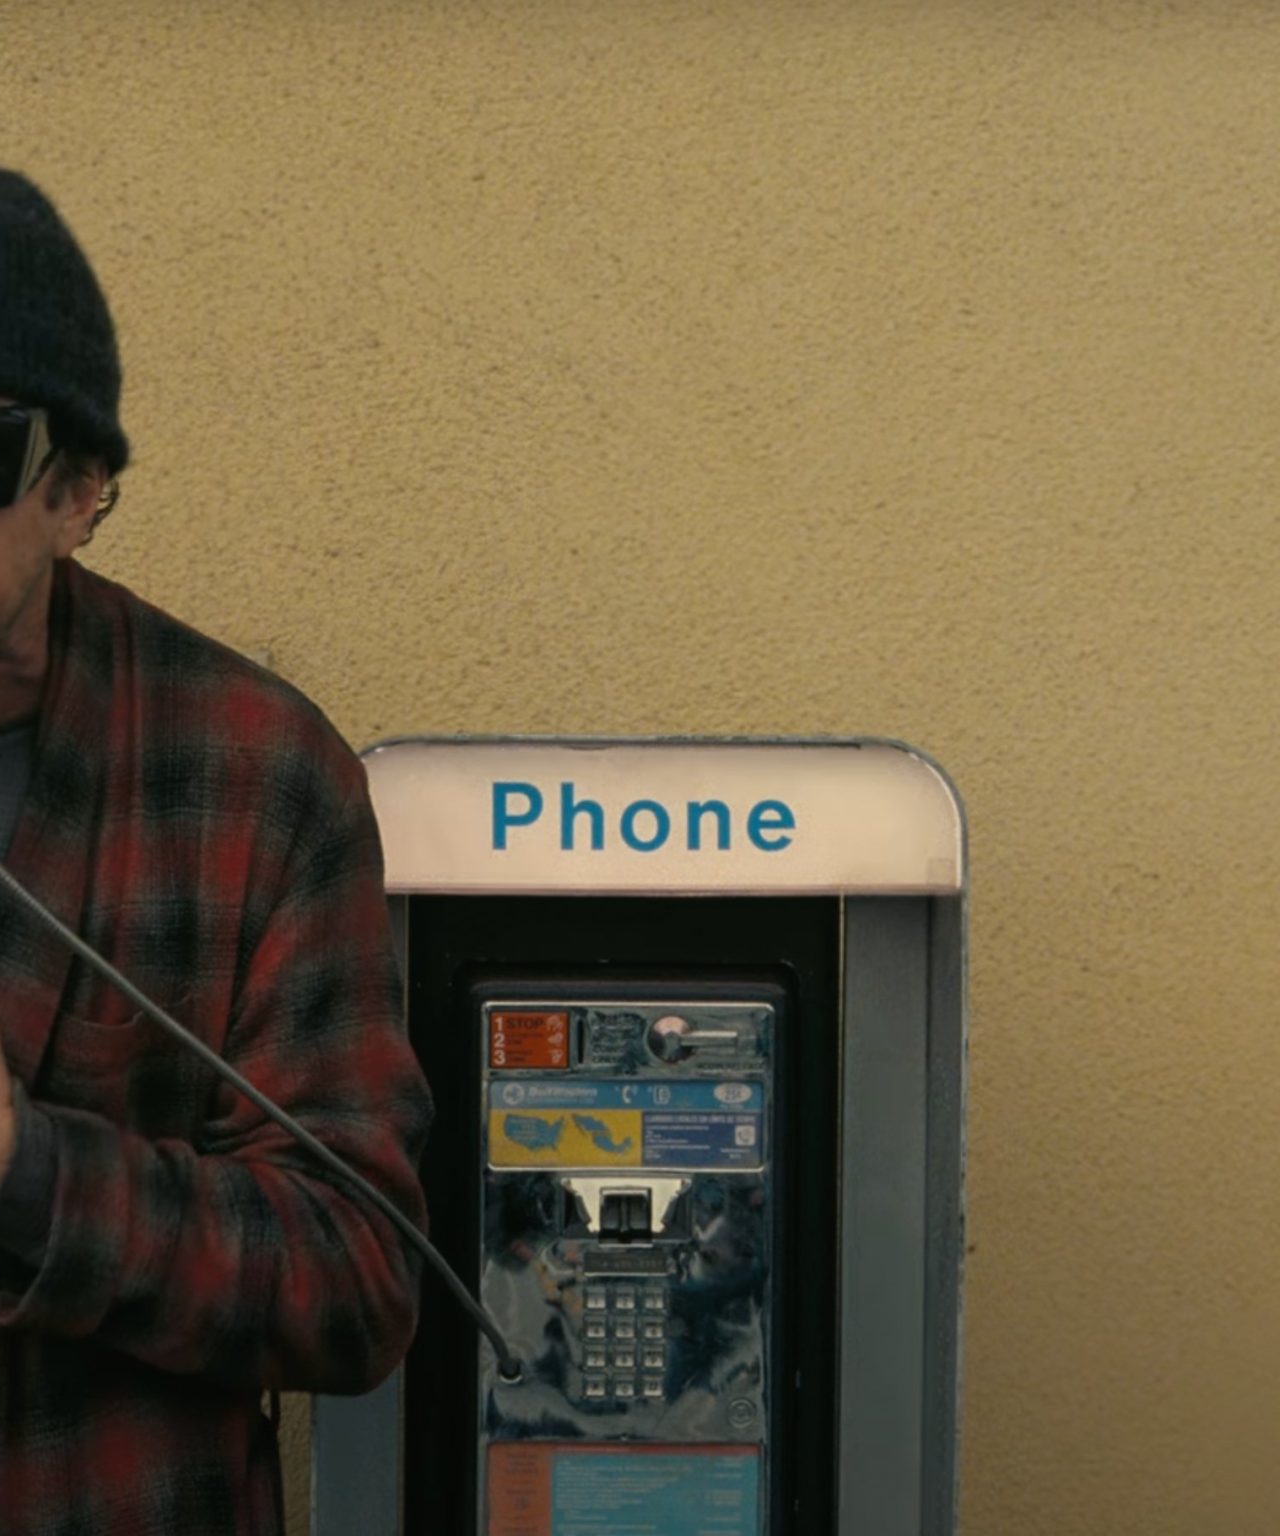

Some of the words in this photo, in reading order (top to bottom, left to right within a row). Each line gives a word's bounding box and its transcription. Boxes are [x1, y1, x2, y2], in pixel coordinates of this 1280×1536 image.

[491, 781, 796, 852] Phone
[494, 1017, 504, 1032] 1
[493, 1032, 505, 1048] 2
[493, 1049, 506, 1065] 3
